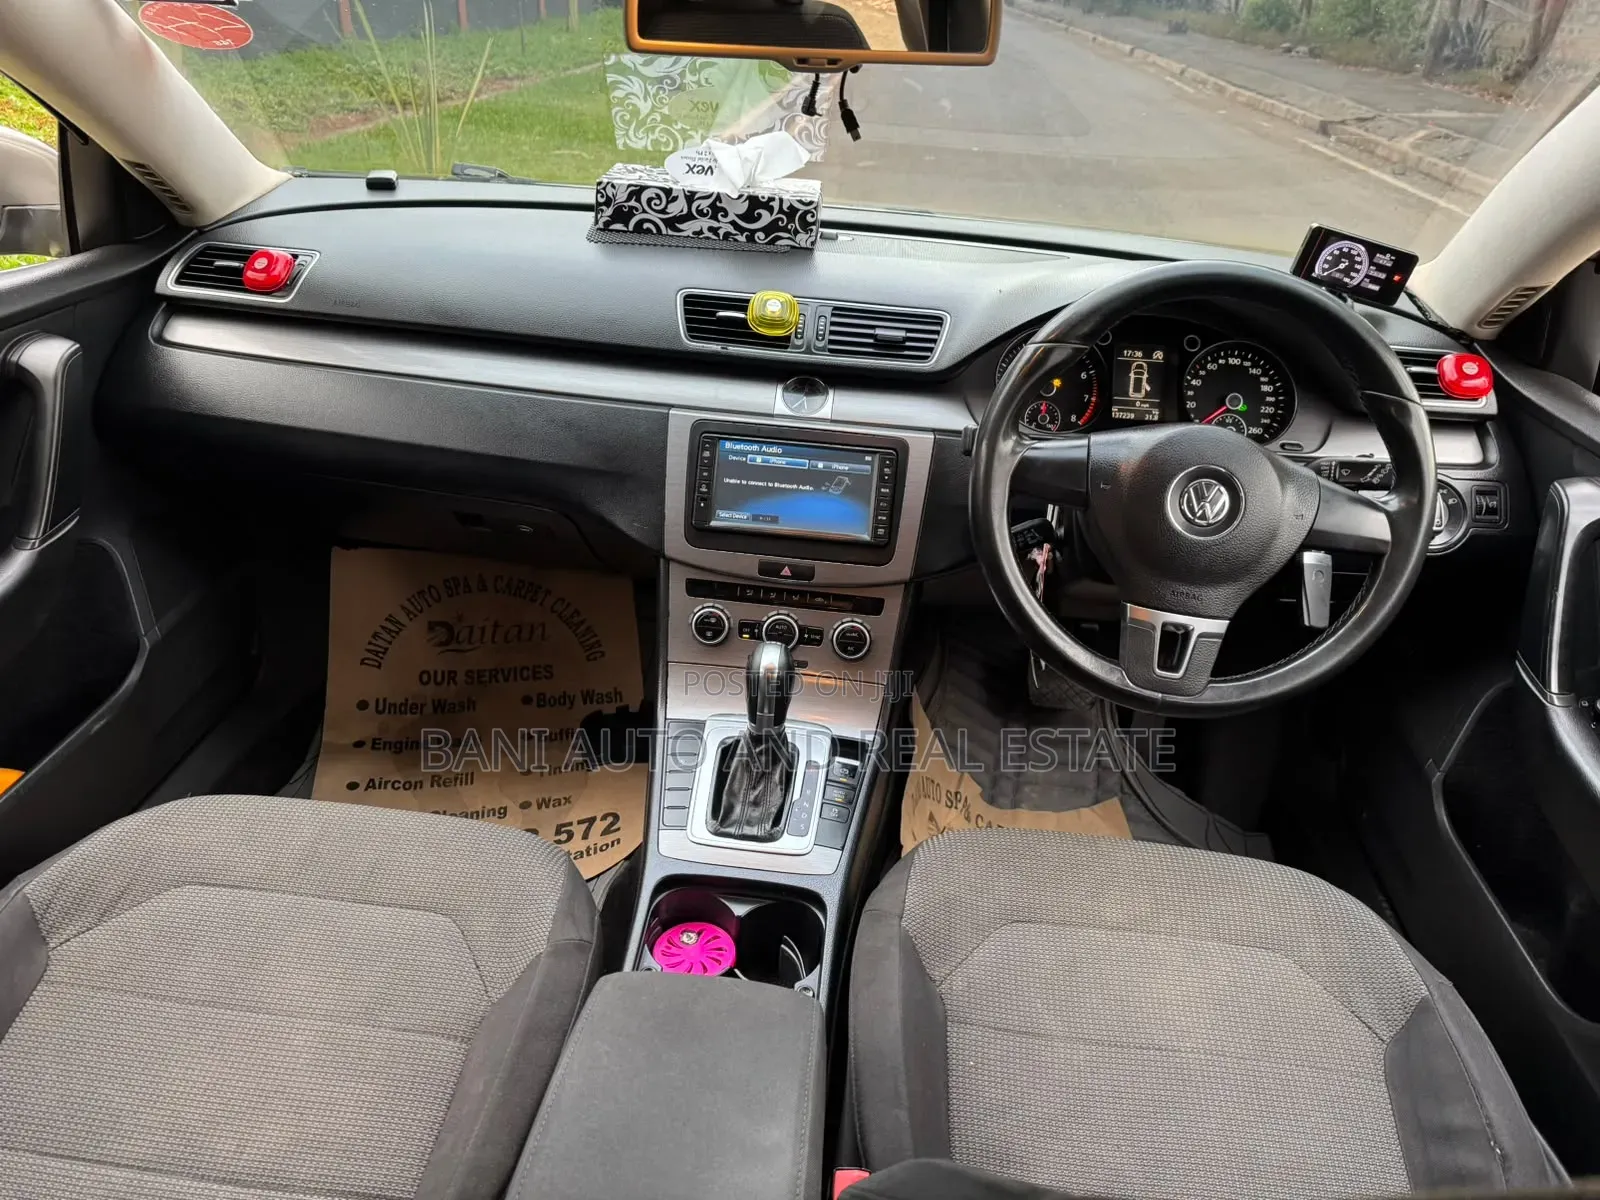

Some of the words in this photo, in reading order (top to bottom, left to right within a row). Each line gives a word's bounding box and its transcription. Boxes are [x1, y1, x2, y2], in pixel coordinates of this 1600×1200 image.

[685, 163, 714, 176] vex
[1123, 349, 1143, 358] 17:36
[1228, 357, 1241, 365] 100
[1080, 371, 1087, 380] 6
[1083, 394, 1089, 402] 7
[1070, 414, 1077, 422] 8
[1248, 426, 1263, 435] 260
[725, 441, 760, 452] Bluetooth
[761, 445, 783, 454] Audio
[728, 454, 746, 462] Device
[832, 463, 849, 471] iPhone
[774, 482, 798, 490] Bluetooth
[732, 512, 748, 520] Device
[360, 613, 408, 670] DAITAN
[400, 584, 441, 622] AUTO
[443, 575, 472, 598] SPA
[477, 573, 488, 592] &
[494, 574, 552, 607] CARPET
[550, 597, 605, 662] CLEANING
[427, 617, 550, 648] Daitan
[418, 669, 458, 686] OUR
[464, 664, 554, 686] SERVICES
[536, 691, 576, 709] Body
[581, 687, 623, 705] Wash
[374, 697, 427, 715] Under
[432, 697, 477, 715] Wash
[364, 777, 424, 791] Aircon
[430, 771, 475, 788] Refill
[921, 775, 942, 804] AUTO
[536, 795, 572, 810] Wax
[553, 812, 621, 845] 572
